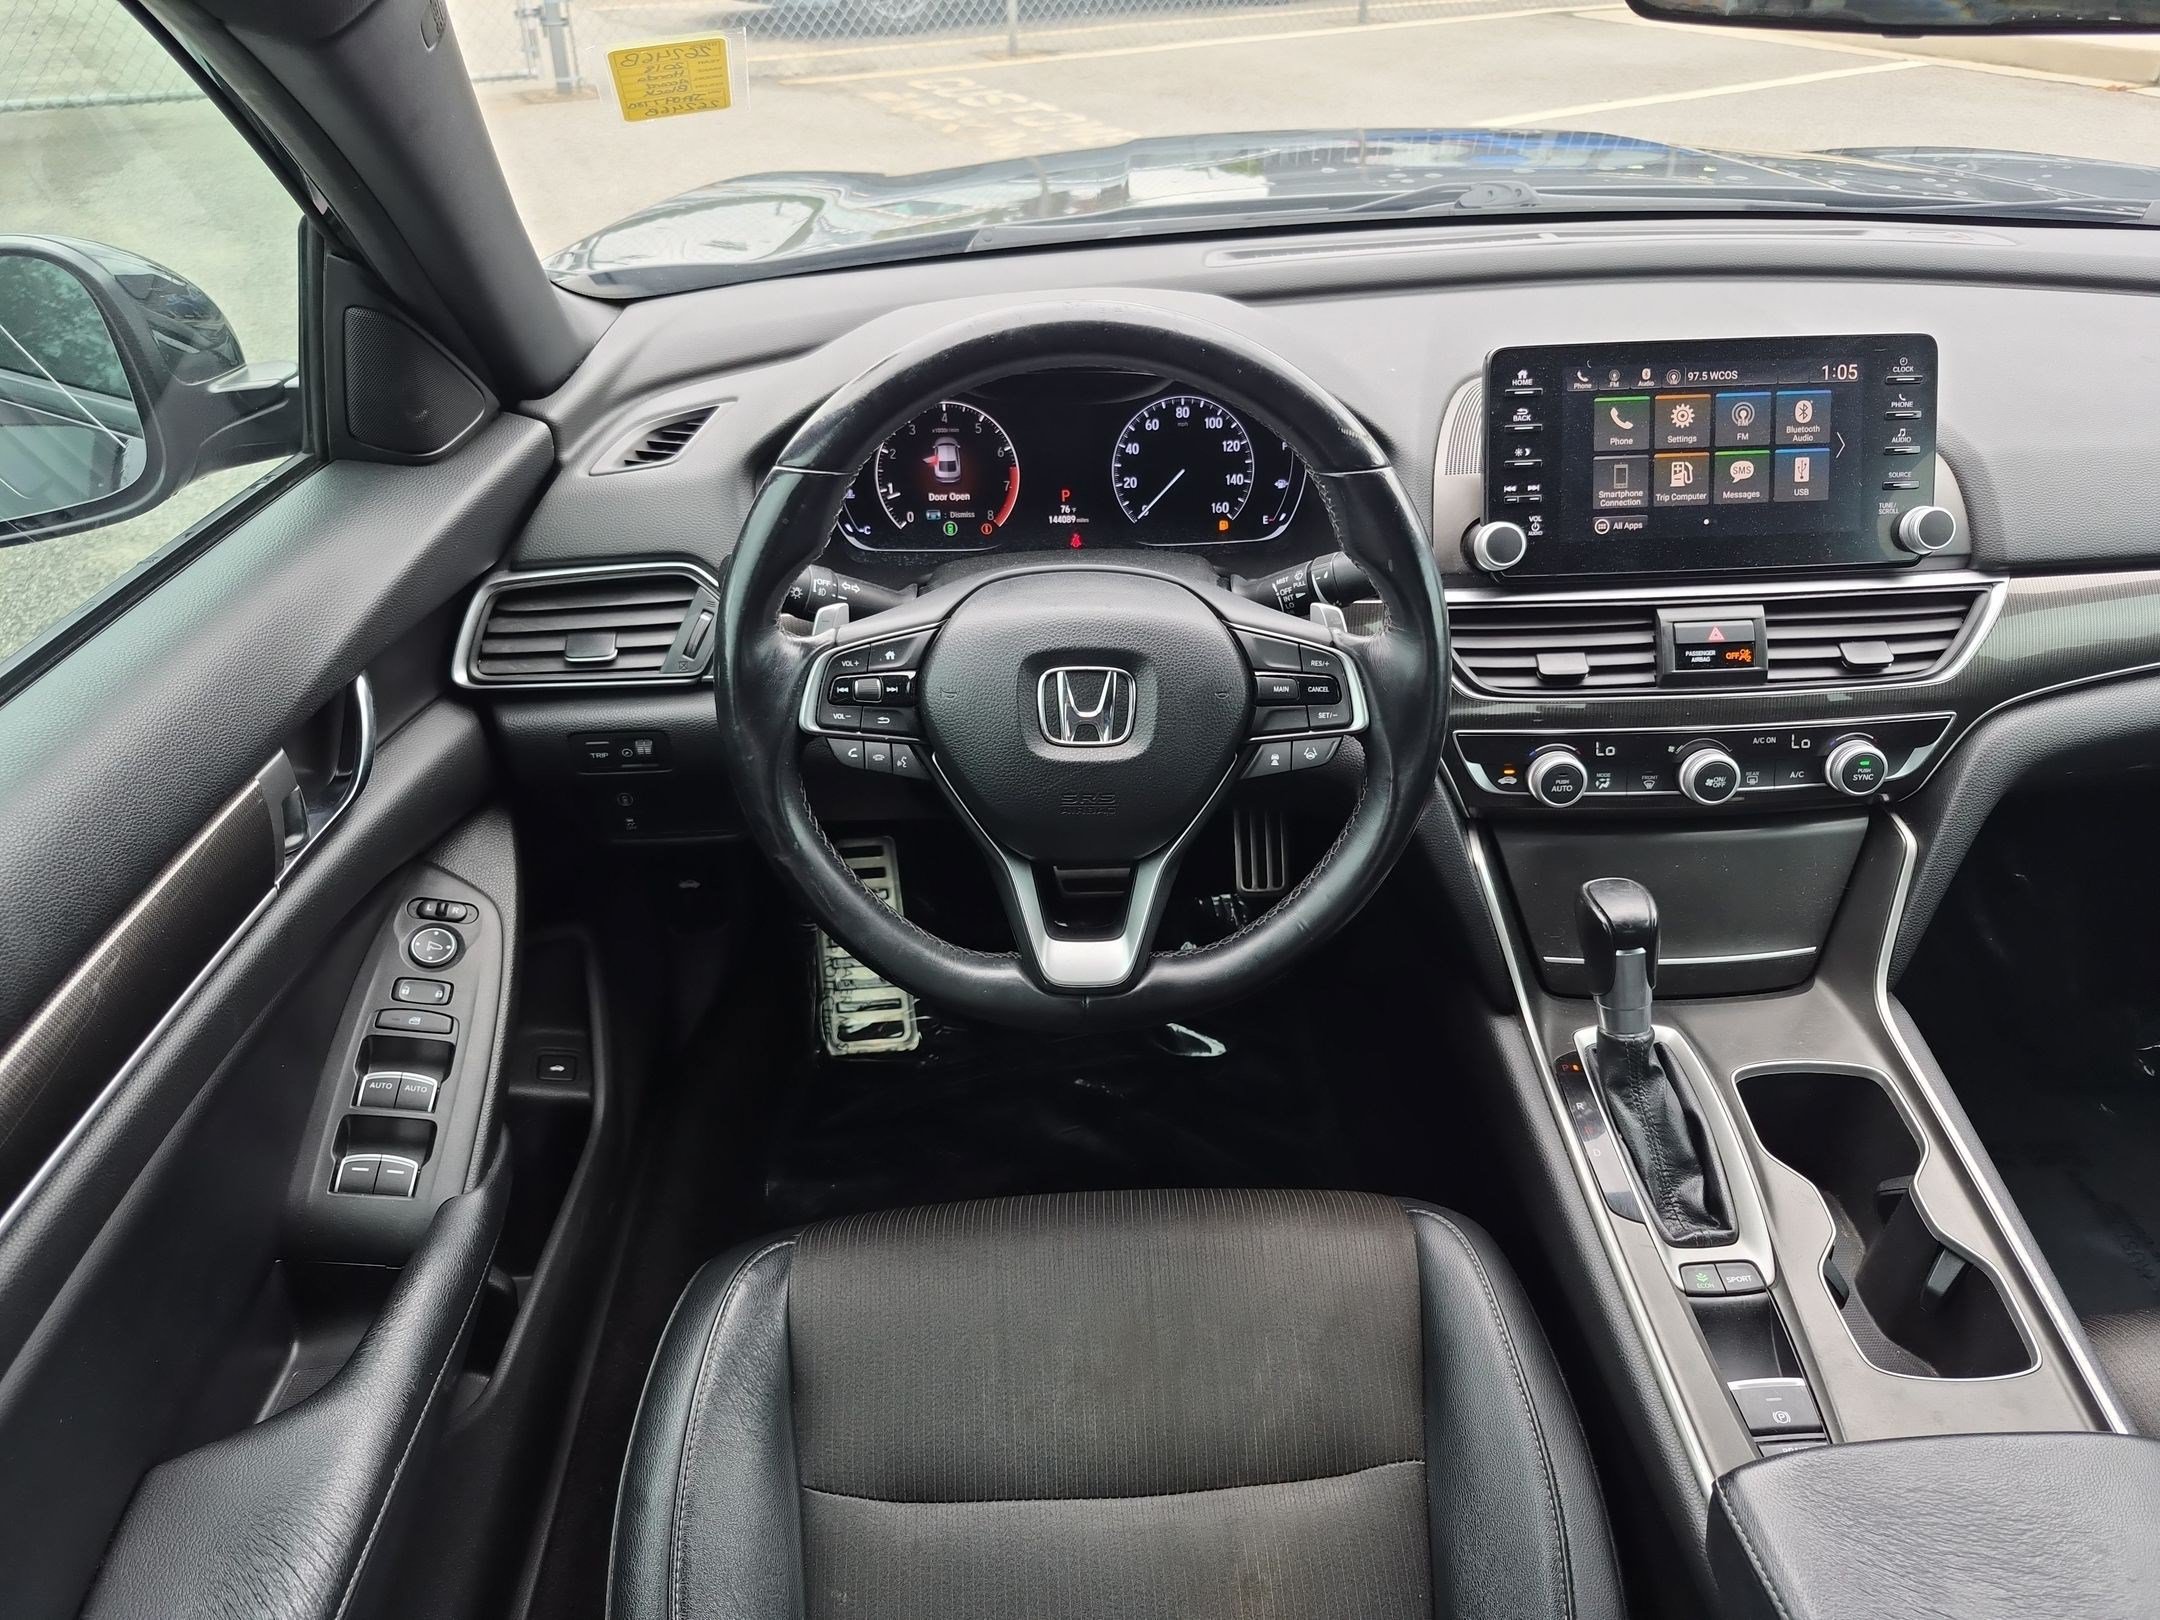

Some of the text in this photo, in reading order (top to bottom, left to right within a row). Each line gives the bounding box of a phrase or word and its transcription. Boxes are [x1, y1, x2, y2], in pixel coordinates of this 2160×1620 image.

[1821, 364, 1858, 380] 1:05
[1892, 365, 1914, 373] CLOCK
[1687, 370, 1738, 381] 97.5 WCOS
[1512, 378, 1533, 386] HOME
[1175, 407, 1189, 418] 80
[941, 413, 948, 423] 4
[1205, 417, 1223, 429] 100
[1513, 414, 1531, 422] BACK
[909, 424, 916, 435] 3
[975, 423, 982, 434] 5
[1145, 419, 1159, 430] 60
[1786, 425, 1820, 434] Bluetooth
[1609, 437, 1633, 446] Phone
[1667, 434, 1697, 444] Settings
[1792, 434, 1814, 442] Audio
[1125, 443, 1140, 455] 40
[1222, 440, 1240, 452] 120
[889, 449, 897, 460] 2
[997, 449, 1004, 458] 6
[1732, 465, 1752, 475] SMS
[1888, 471, 1912, 479] SOURCE
[1123, 477, 1137, 489] 20
[1226, 474, 1244, 486] 140
[887, 483, 893, 493] 1
[1003, 481, 1010, 491] 7
[928, 492, 970, 501] Door Open
[1061, 489, 1070, 502] P
[1598, 490, 1643, 500] Smartphone
[1655, 492, 1707, 502] Trip Computer
[1722, 490, 1760, 500] Messages
[1794, 488, 1809, 496] USB
[1600, 498, 1641, 507] Connection
[1060, 504, 1070, 513] 76
[1211, 502, 1230, 514] 160
[907, 511, 914, 522] 0
[987, 510, 994, 520] 8
[1048, 514, 1076, 524] 144089
[1262, 515, 1269, 525] E
[1612, 520, 1643, 530] All Apps
[864, 526, 871, 535] C
[817, 578, 831, 587] OFF
[1293, 581, 1306, 589] PULL
[1280, 586, 1293, 596] OFF
[1685, 649, 1716, 657] PASSENGER
[1726, 652, 1739, 660] OFF
[1790, 771, 1805, 779] A/C
[1852, 773, 1874, 781] SYNC
[1551, 785, 1573, 793] AUTO
[369, 1081, 393, 1090] AUTO
[404, 1084, 428, 1093] AUTO
[1575, 1102, 1584, 1110] R
[1726, 1275, 1752, 1283] SPORT
